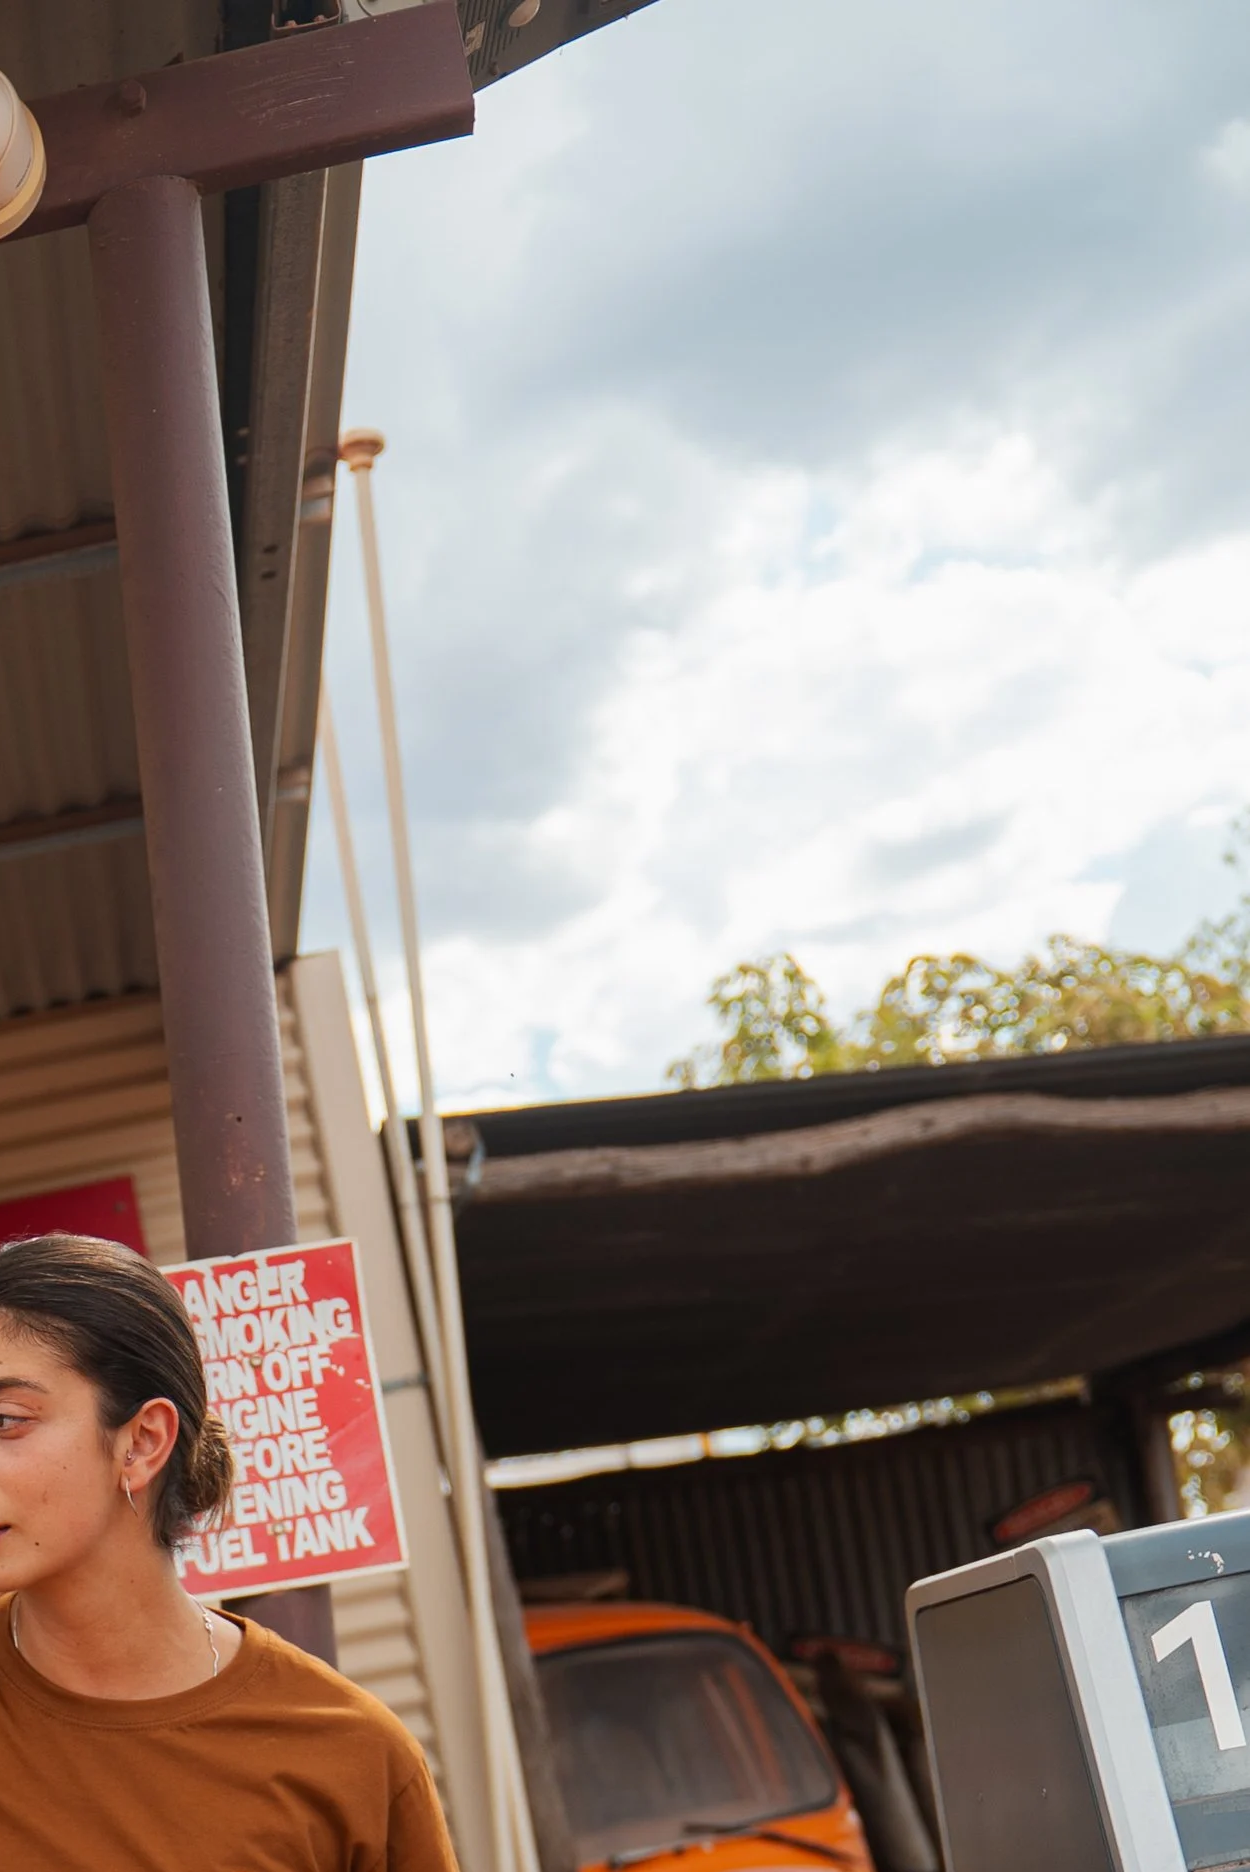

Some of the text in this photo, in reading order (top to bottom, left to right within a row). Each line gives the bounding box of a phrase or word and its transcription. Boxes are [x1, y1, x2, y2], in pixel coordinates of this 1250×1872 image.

[174, 1259, 311, 1318] ANGER
[205, 1344, 332, 1402] RN OFF
[233, 1428, 332, 1483] FORE
[267, 1506, 375, 1561] TANK
[1152, 1600, 1246, 1750] 1
